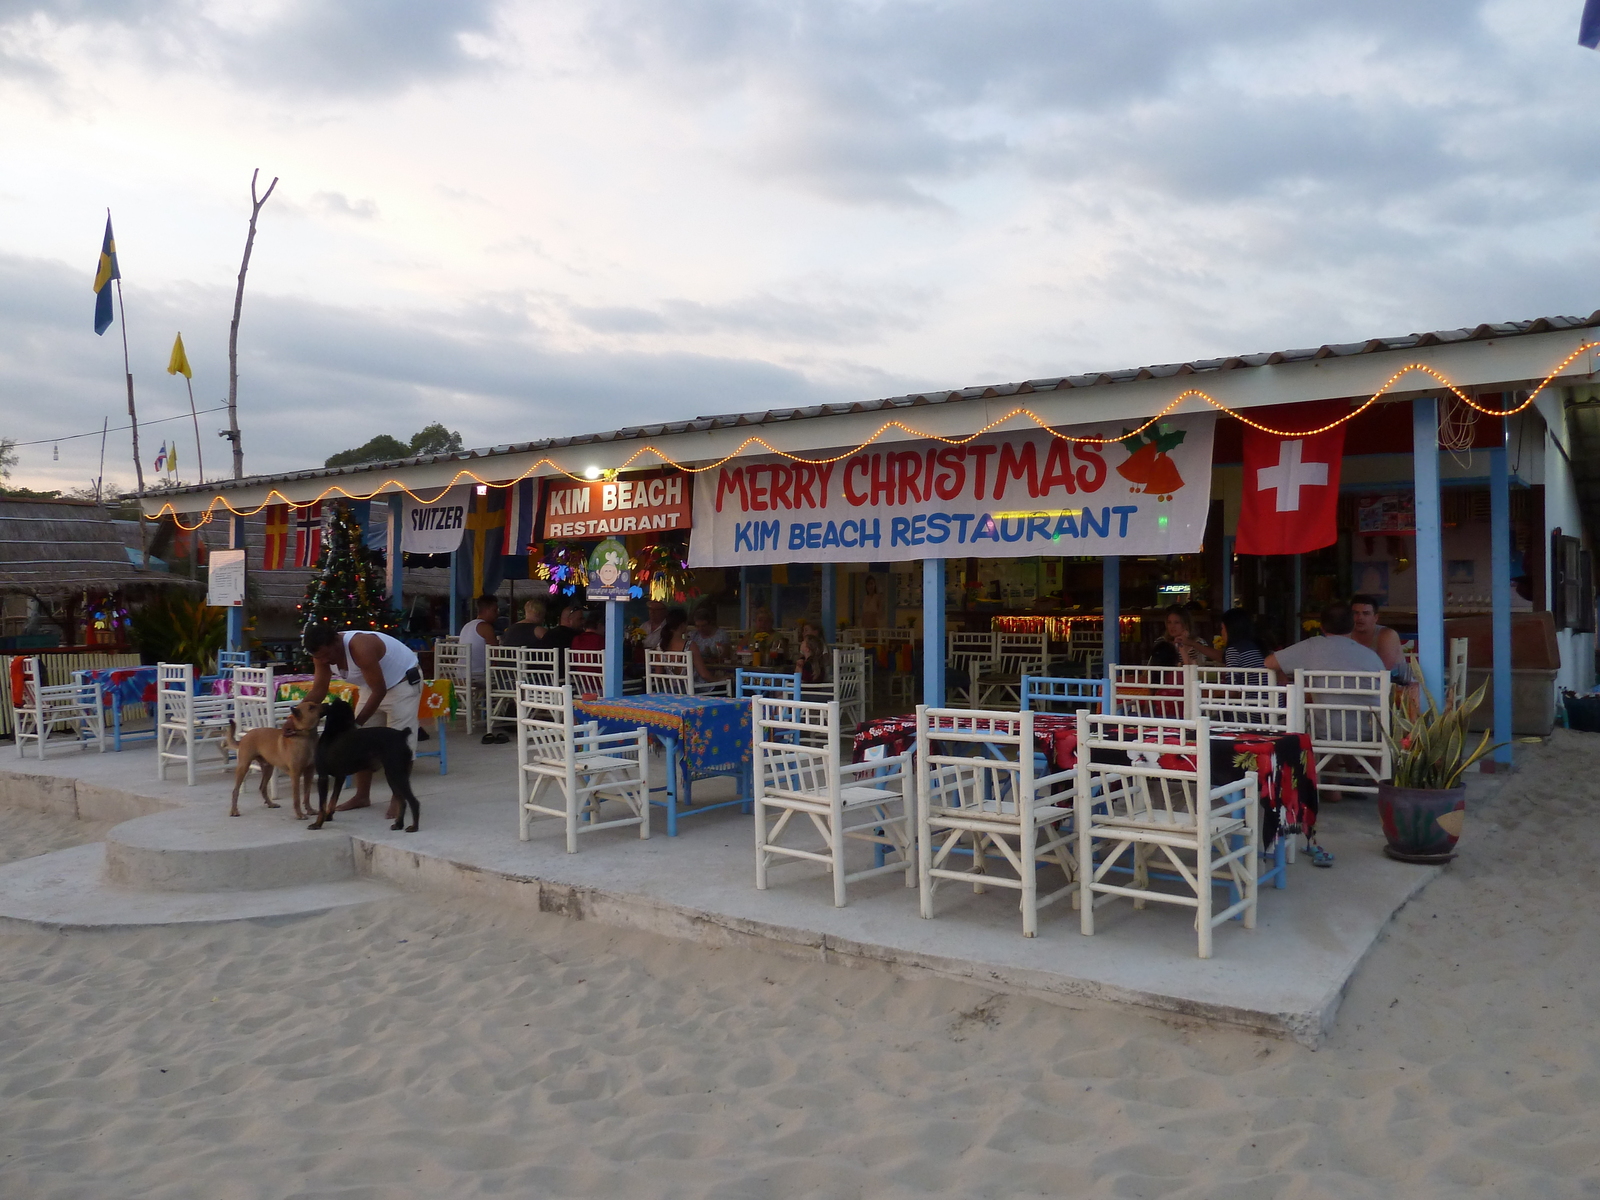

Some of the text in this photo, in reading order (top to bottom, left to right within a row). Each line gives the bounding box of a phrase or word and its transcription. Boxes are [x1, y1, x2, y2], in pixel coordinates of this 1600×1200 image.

[715, 433, 1107, 513] MERRY CHRISTMAS
[550, 477, 682, 516] KIM BEACH
[411, 506, 463, 531] SVITZER
[550, 512, 680, 537] RESTAURANT
[734, 505, 1138, 553] KIM BEACH RESTAURANT
